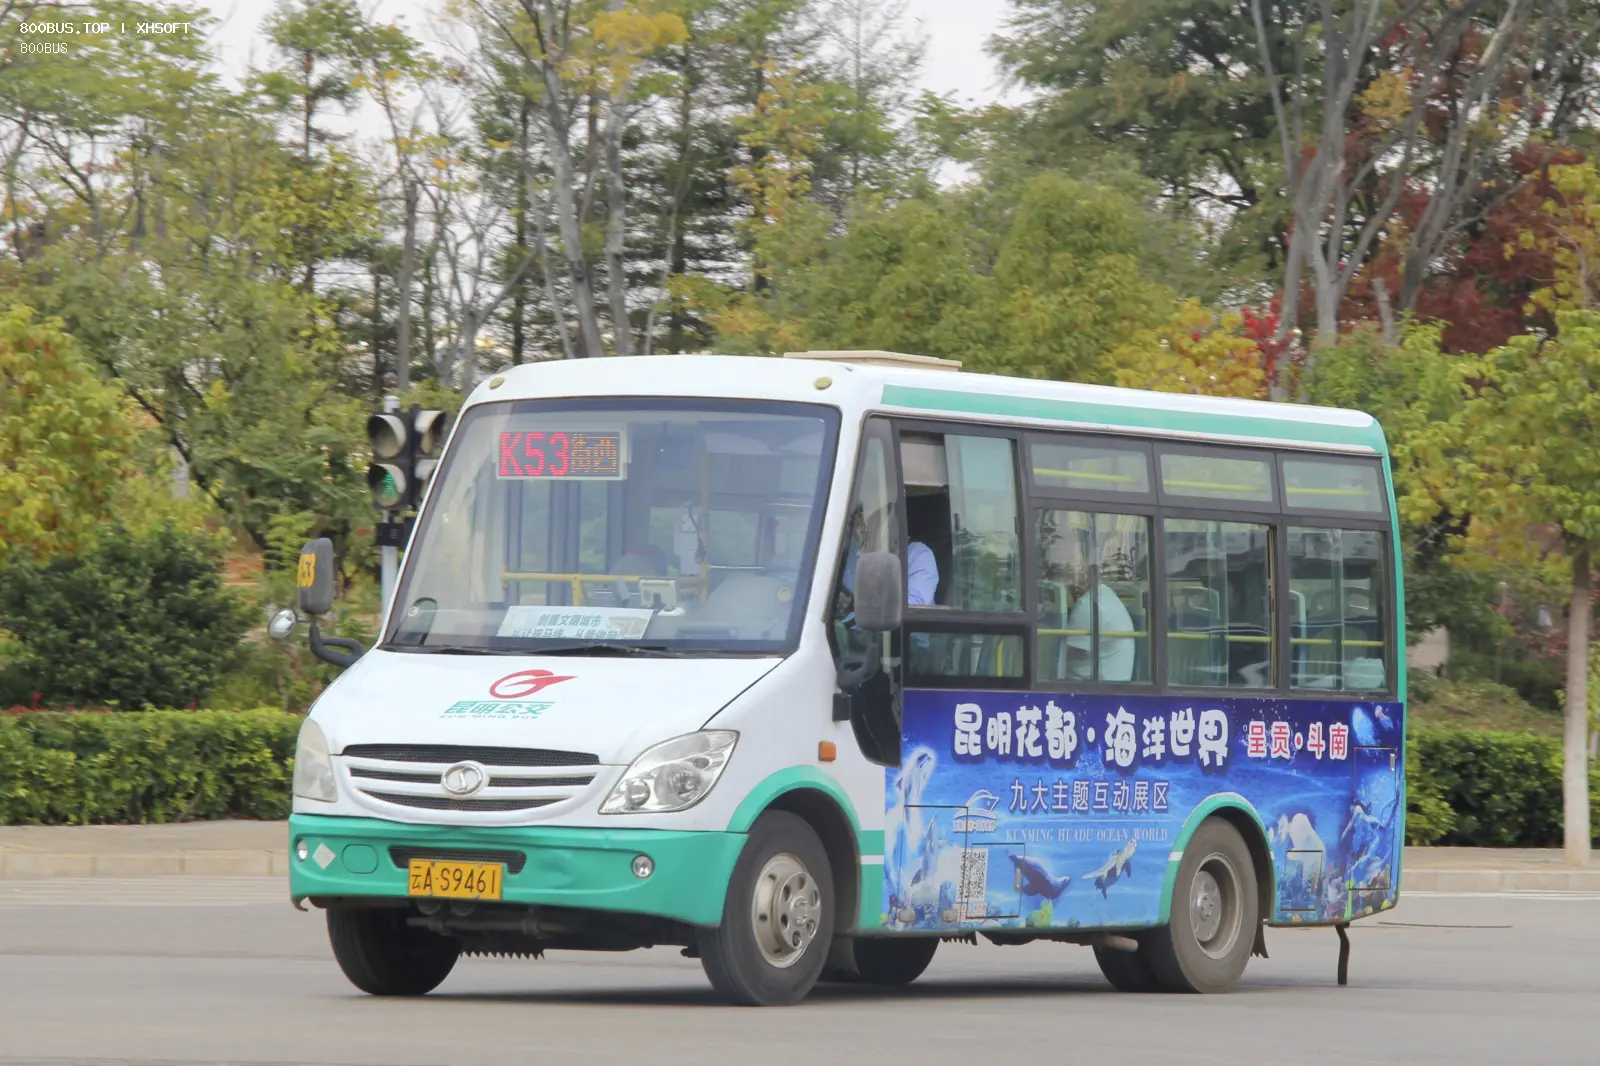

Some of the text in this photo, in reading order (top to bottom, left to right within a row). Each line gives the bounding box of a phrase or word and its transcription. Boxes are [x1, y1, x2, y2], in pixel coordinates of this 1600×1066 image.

[499, 432, 569, 476] K53
[443, 700, 556, 714] 昆明公交
[954, 700, 1230, 767] 昆明花都·海洋世界
[1248, 721, 1349, 760] 呈贡·斗南
[1009, 779, 1169, 811] 九大主题互动展区
[1005, 828, 1168, 842] KUNMING HUADU OCEAN WORLD
